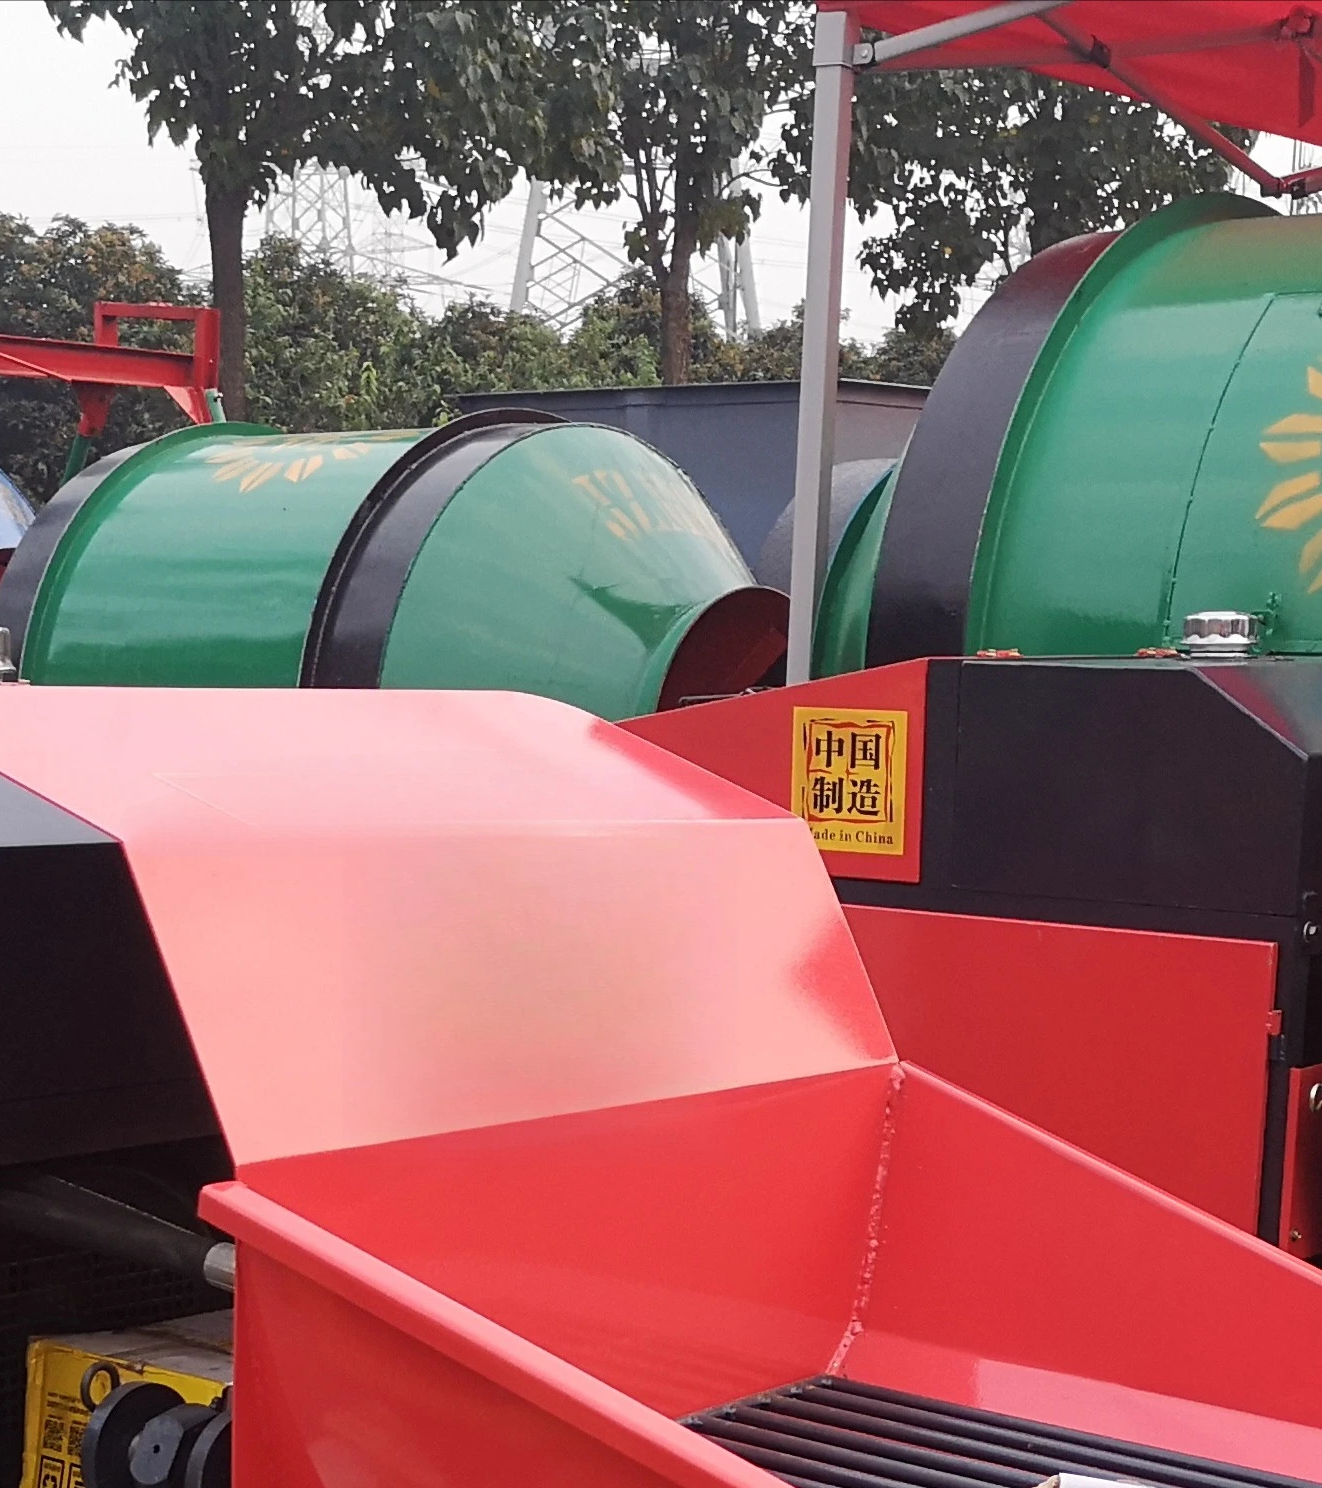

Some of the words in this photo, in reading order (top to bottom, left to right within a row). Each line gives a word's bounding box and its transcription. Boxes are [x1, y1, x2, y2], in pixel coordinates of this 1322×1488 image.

[814, 730, 882, 771] 中国
[811, 775, 881, 817] 制造
[810, 827, 836, 842] ade
[839, 829, 853, 843] in
[855, 831, 894, 845] China
